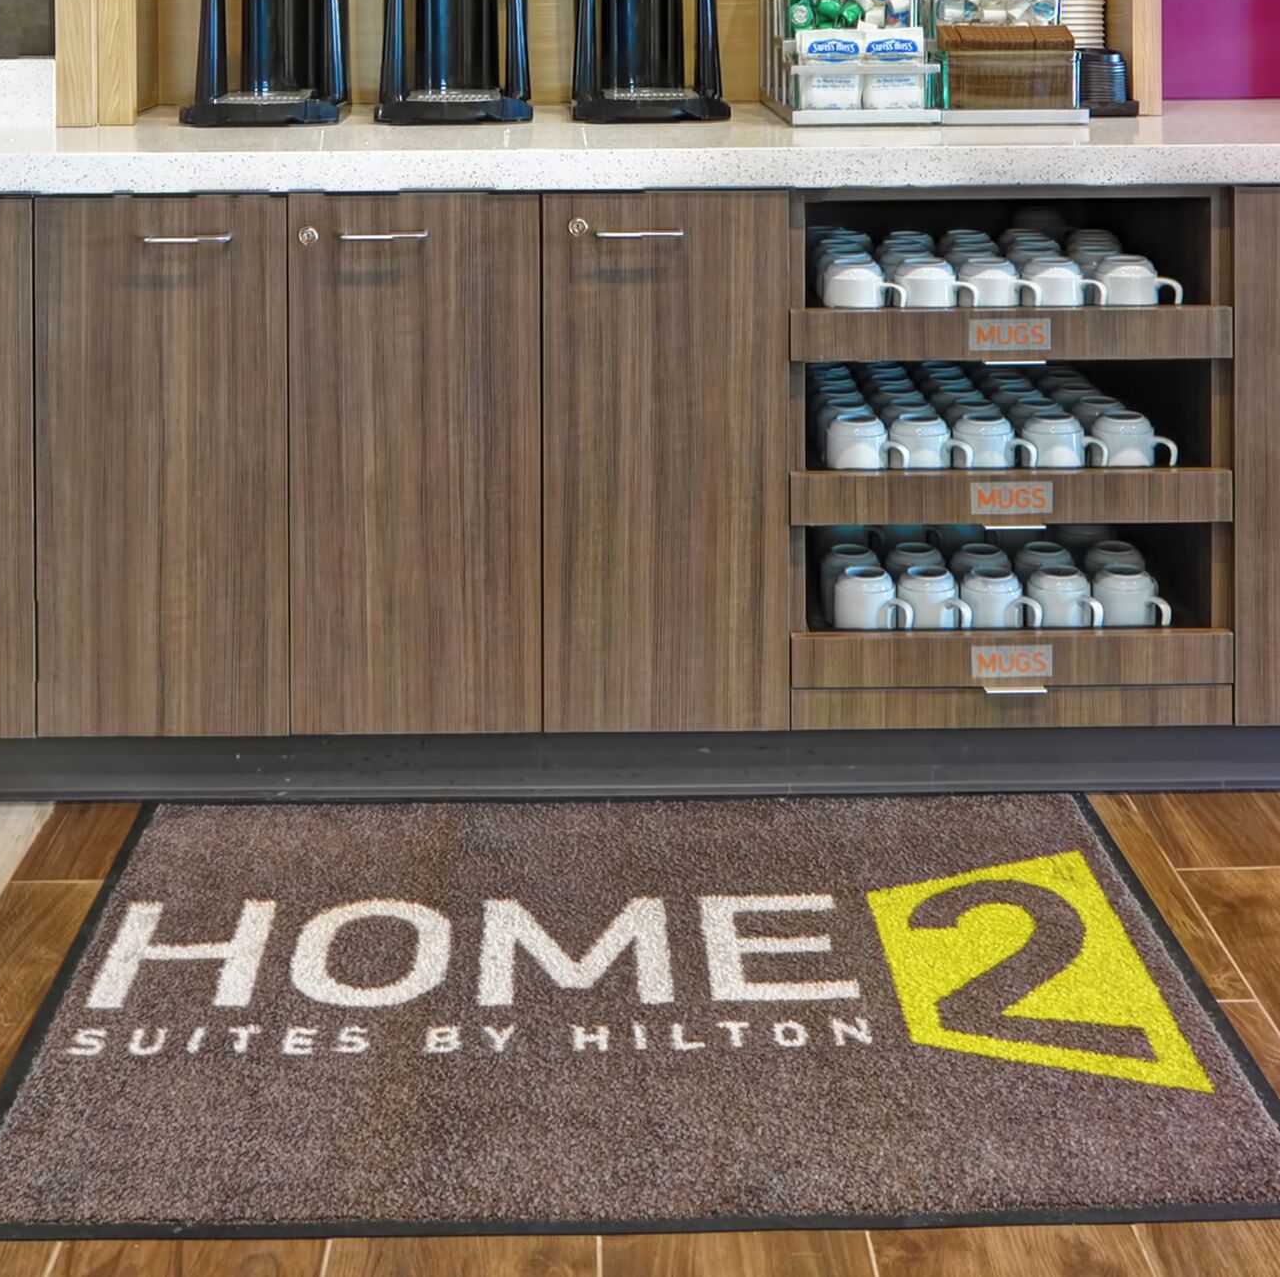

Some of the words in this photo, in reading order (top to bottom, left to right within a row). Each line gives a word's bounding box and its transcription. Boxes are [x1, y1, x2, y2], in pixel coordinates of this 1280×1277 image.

[975, 324, 1046, 345] MUGS
[977, 488, 1047, 509] MUGS
[977, 651, 1047, 672] MUGS
[86, 894, 860, 1008] HOME
[908, 879, 1160, 1064] 2
[65, 1026, 370, 1055] SUITES
[424, 1025, 515, 1054] BY
[571, 1018, 873, 1052] HILTON
